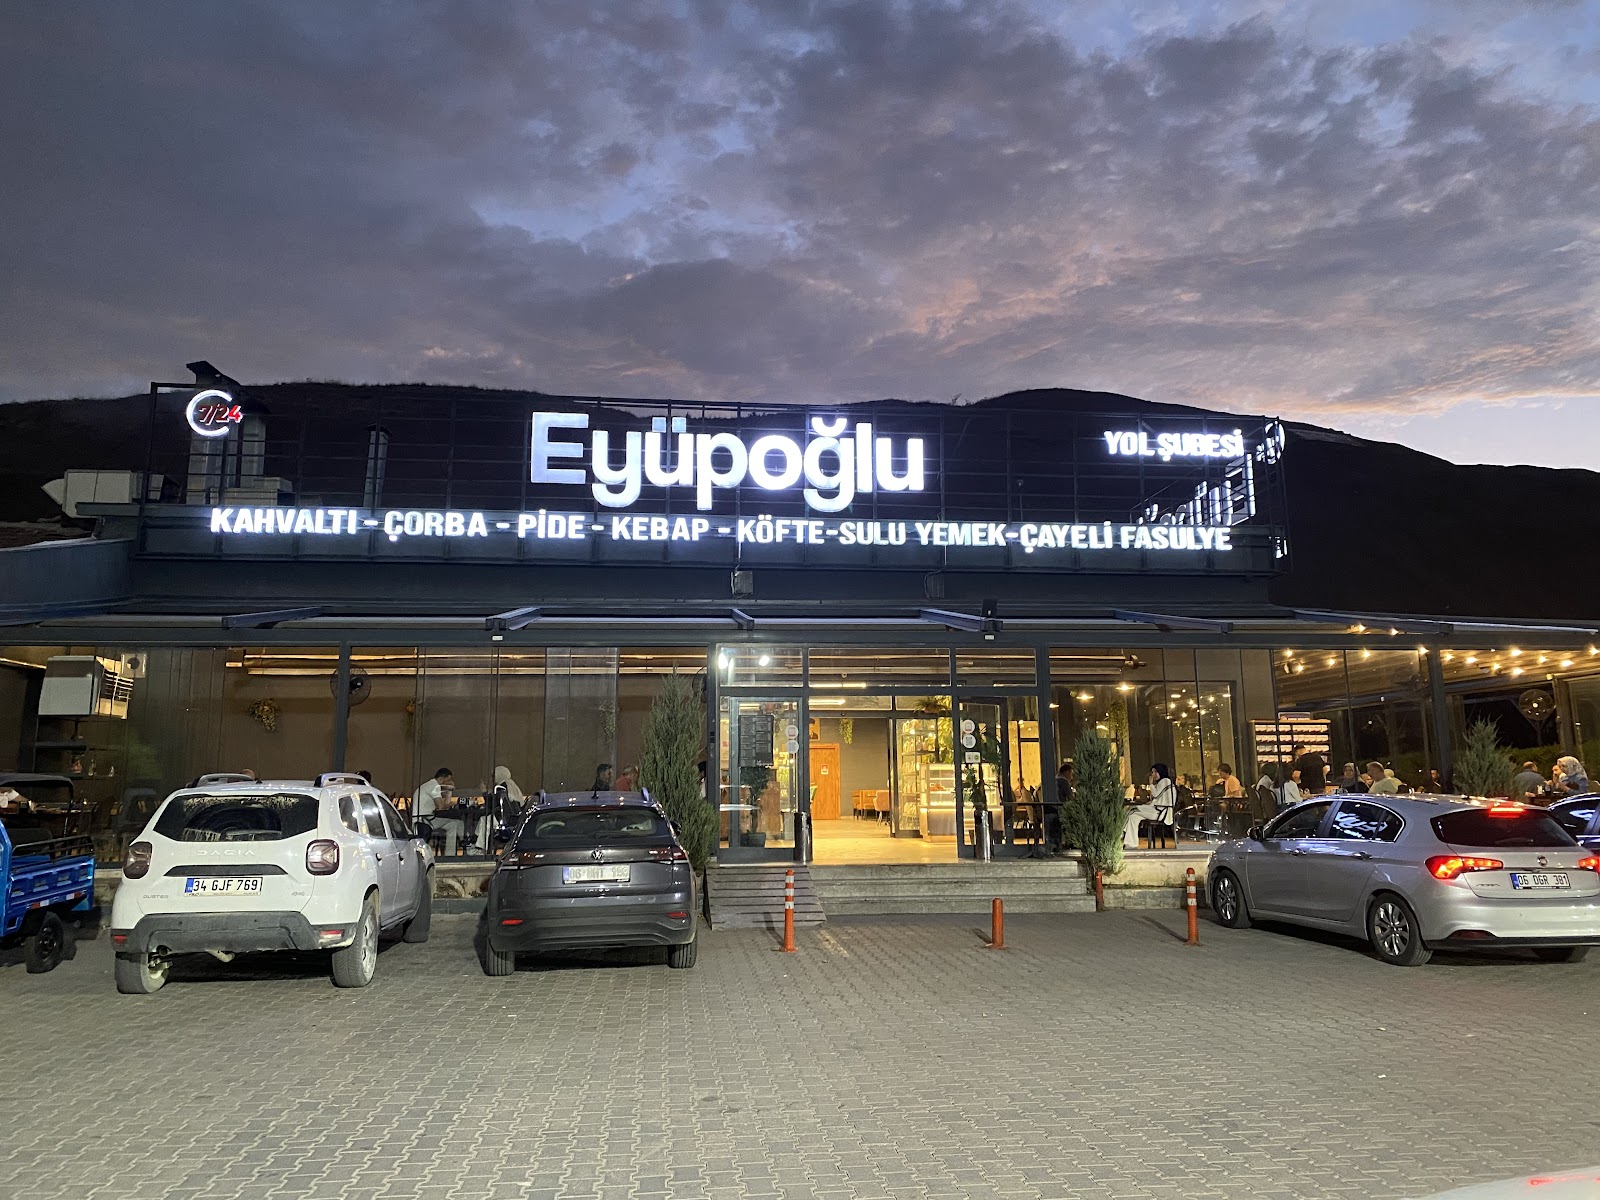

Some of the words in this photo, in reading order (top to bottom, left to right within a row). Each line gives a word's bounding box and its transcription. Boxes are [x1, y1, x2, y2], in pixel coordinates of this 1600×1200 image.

[197, 404, 243, 425] 7/24
[1104, 431, 1155, 456] YOL
[1157, 429, 1245, 462] ŞUBESİ
[531, 411, 924, 513] Eyüpoğlu
[210, 507, 357, 535] KAHVALTI
[384, 510, 488, 542] ÇORBA
[518, 508, 586, 540] PİDE
[612, 516, 709, 541] KEBAP
[1120, 525, 1233, 551] FASULYE
[193, 879, 207, 892] 34
[211, 879, 234, 891] GJF
[236, 878, 259, 891] 769
[1517, 874, 1530, 886] 06
[1553, 874, 1569, 886] 381
